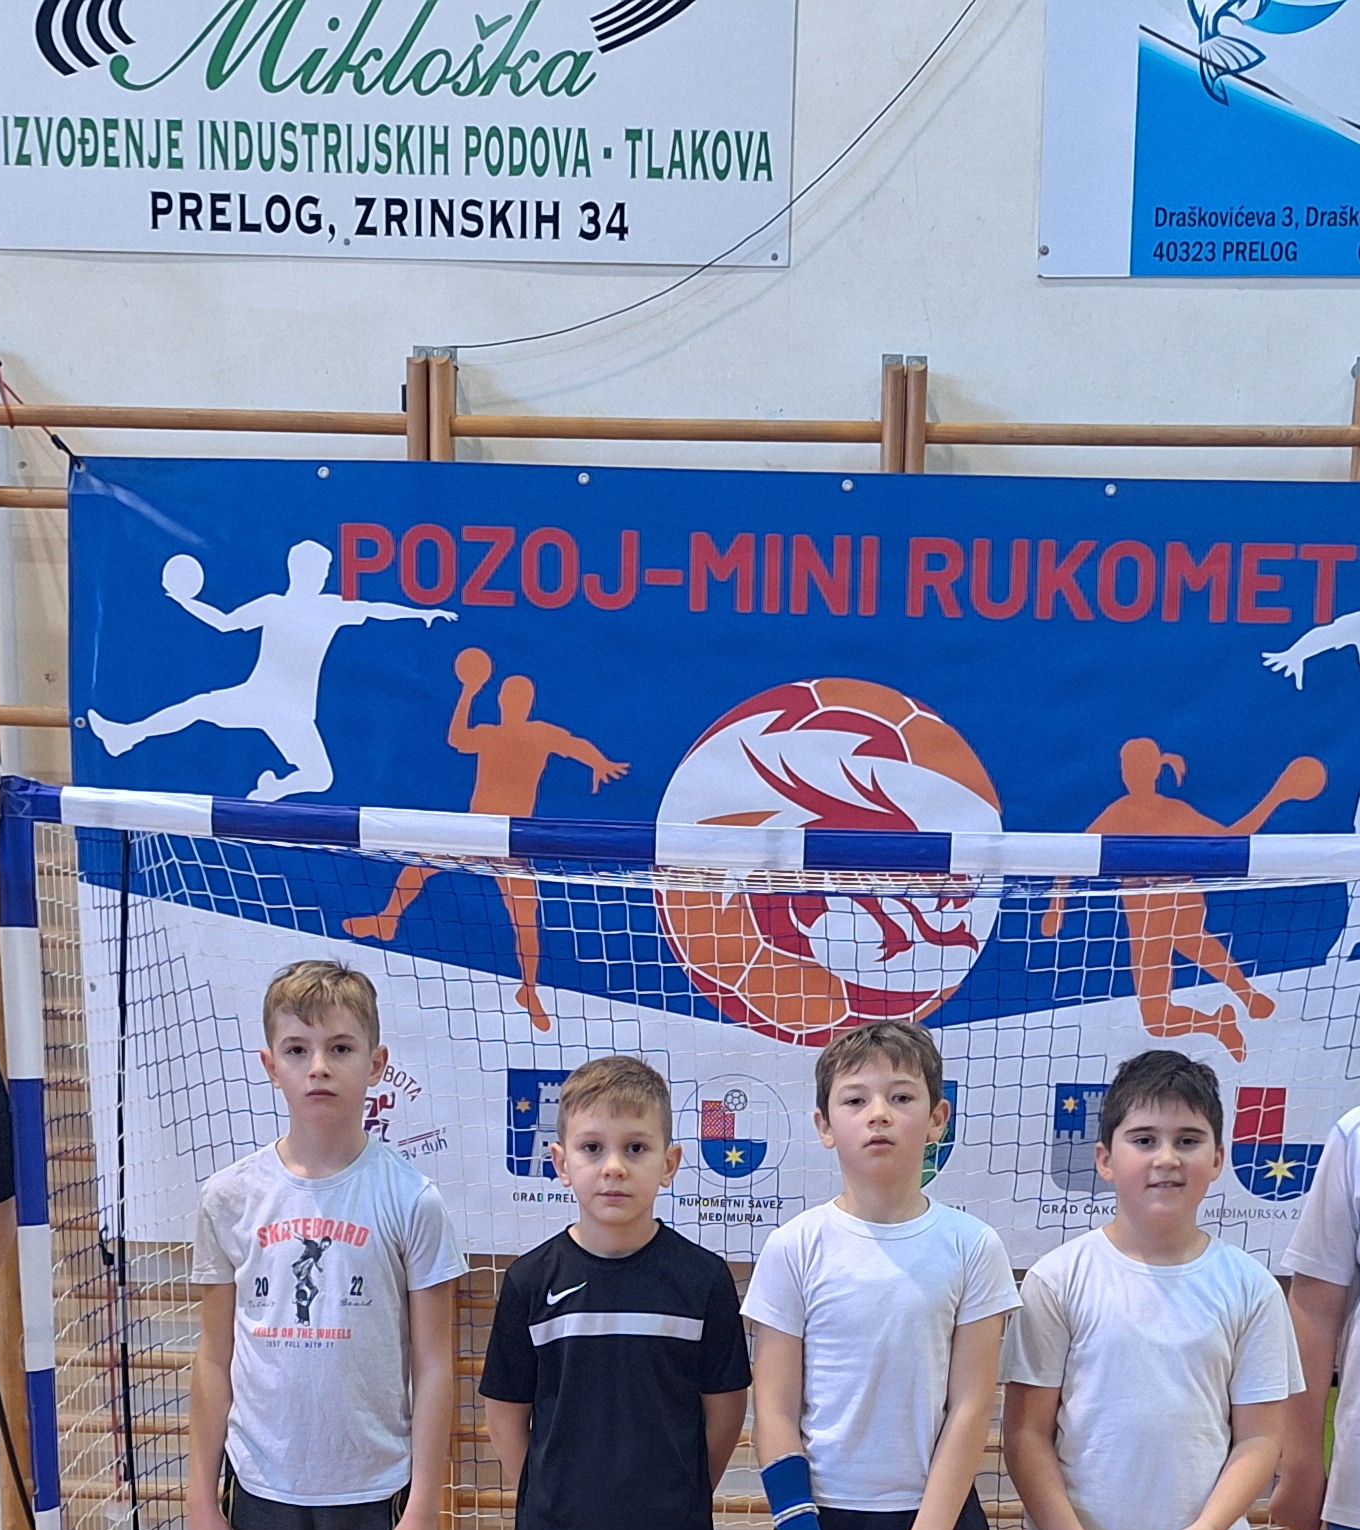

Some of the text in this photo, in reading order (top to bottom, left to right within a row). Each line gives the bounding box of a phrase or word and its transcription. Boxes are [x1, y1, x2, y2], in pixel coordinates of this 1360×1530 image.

[110, 0, 597, 98] Mikloška
[2, 115, 183, 170] IZVOĐENJE
[198, 119, 450, 175] INDUSTRIJSKIH
[465, 126, 592, 178] PODOVA
[624, 127, 773, 181] TLAKOVA
[151, 191, 629, 243] PRELOG, ZRINSKIH 34
[1155, 205, 1276, 228] Draškovićeva
[1281, 206, 1299, 230] 3,
[1153, 241, 1216, 262] 40323
[1223, 241, 1298, 262] PRELOG
[340, 523, 1359, 624] POZOJ-MINI RUKOMET
[383, 1065, 422, 1102] BOTA
[513, 1192, 578, 1204] GRAD PREL
[679, 1198, 783, 1210] RUKOMETNI SAVEZ
[1042, 1203, 1117, 1215] GRAD ČAKO
[1204, 1208, 1287, 1219] MEĐIMURSKA
[257, 1218, 370, 1248] SKATEBOARD
[255, 1276, 363, 1297] 20 22
[281, 1328, 293, 1338] ON
[297, 1328, 313, 1338] THE
[317, 1328, 352, 1339] WHEELS
